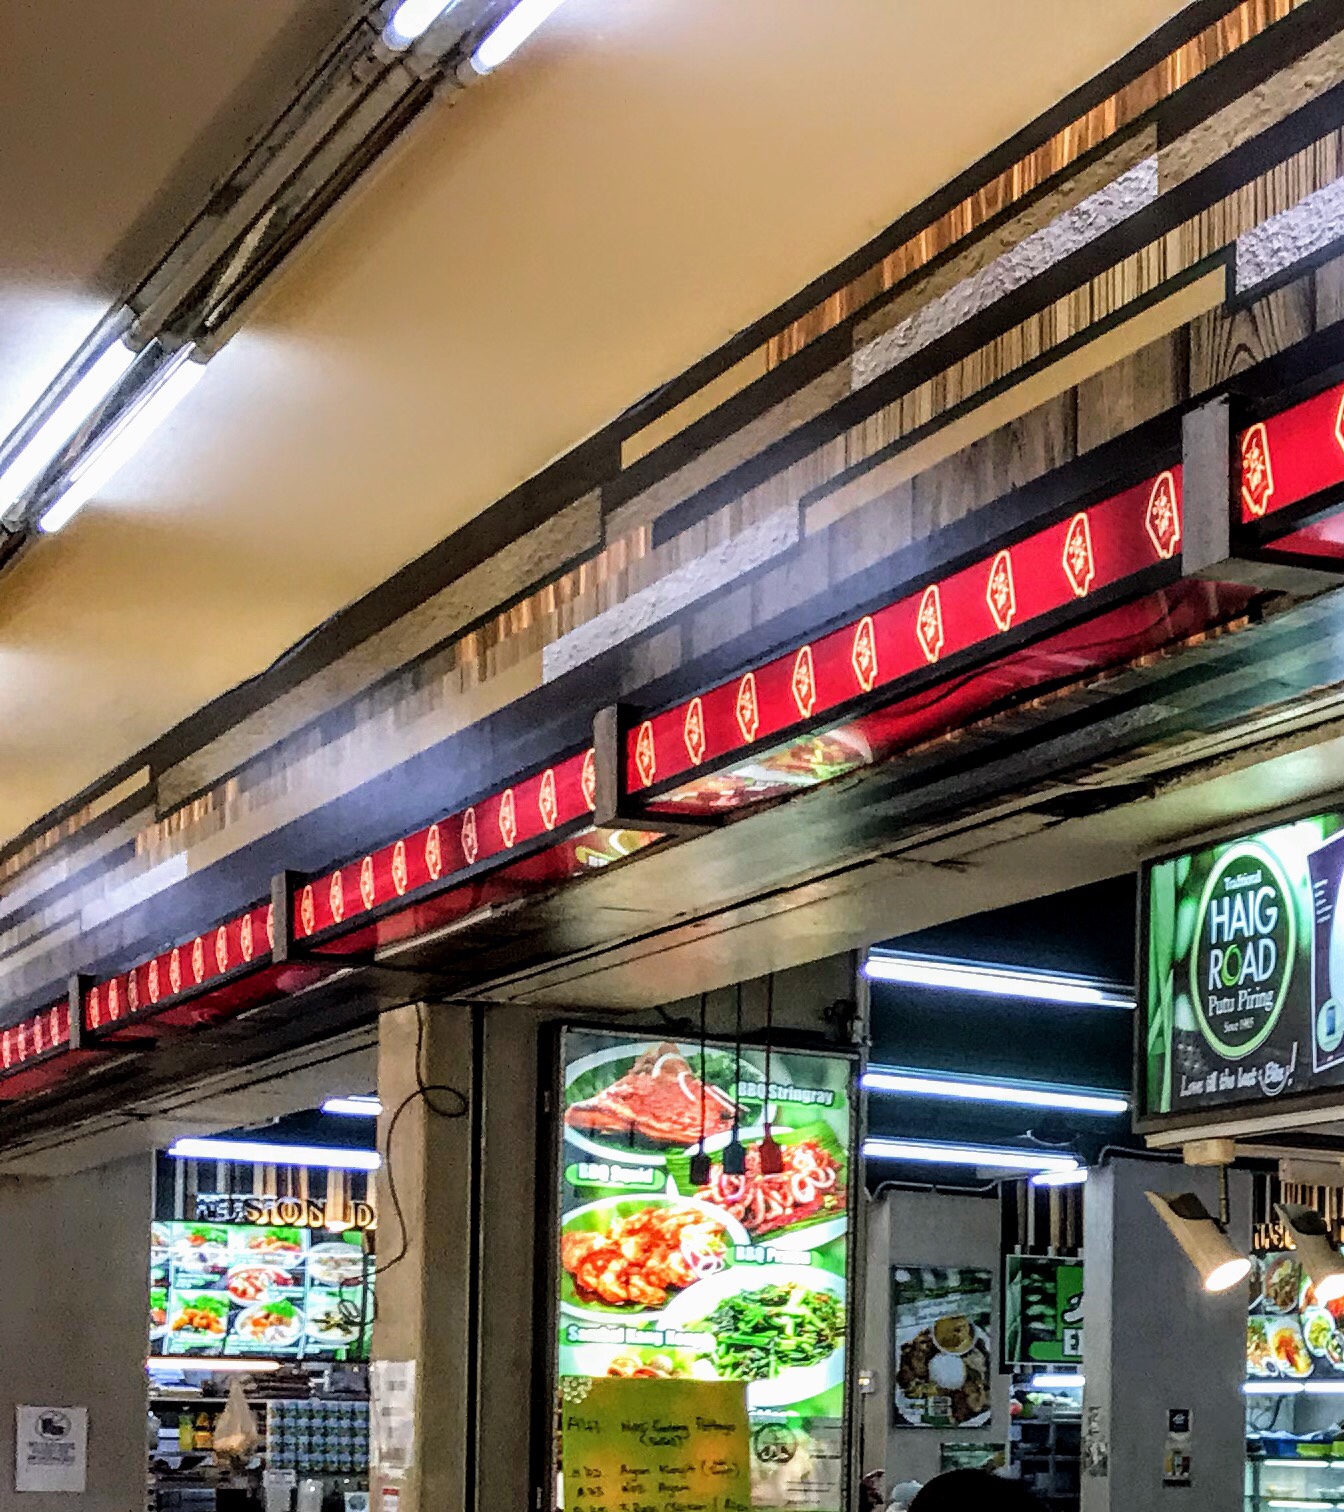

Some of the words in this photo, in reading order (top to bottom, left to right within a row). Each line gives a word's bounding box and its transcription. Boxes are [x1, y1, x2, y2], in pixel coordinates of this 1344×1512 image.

[1209, 886, 1278, 945] HAIG
[1208, 938, 1277, 990] ROAD
[1208, 994, 1235, 1017] Putu
[1238, 986, 1275, 1013] Piring
